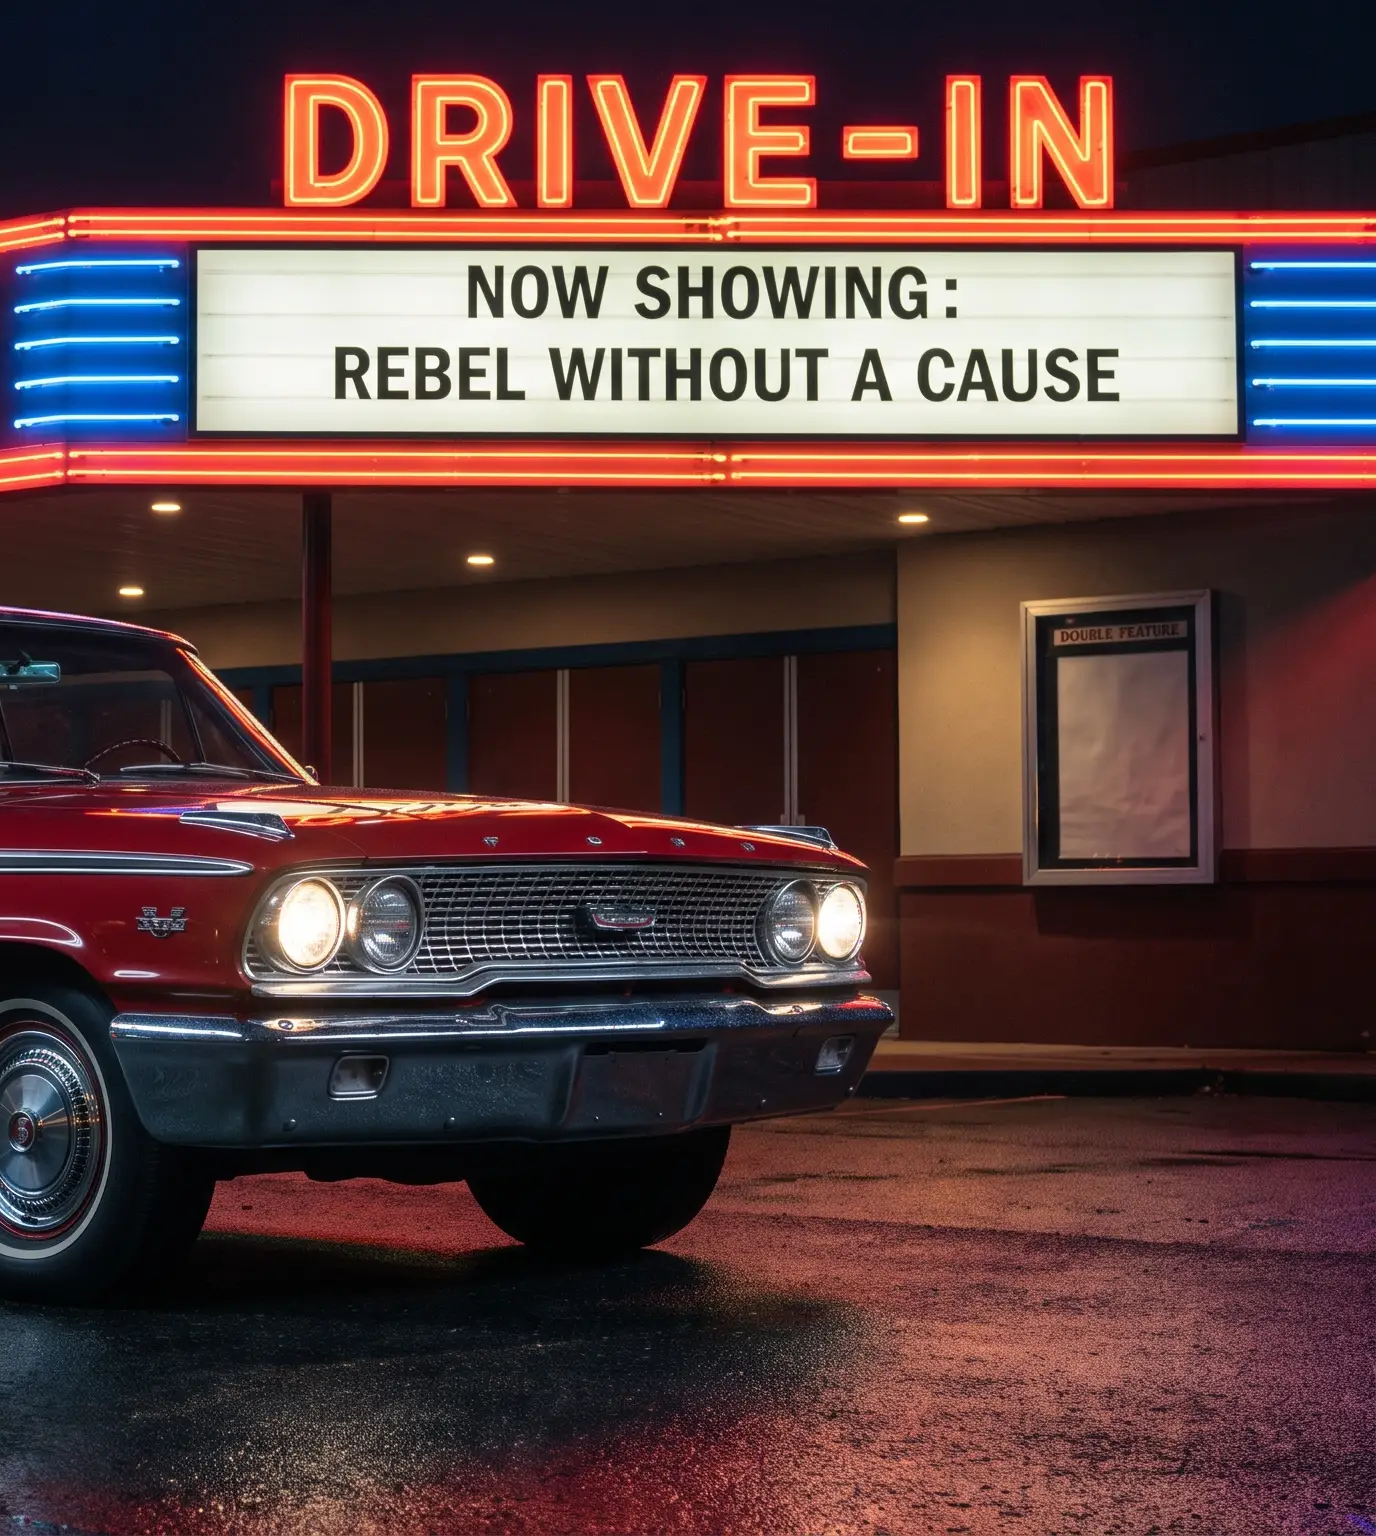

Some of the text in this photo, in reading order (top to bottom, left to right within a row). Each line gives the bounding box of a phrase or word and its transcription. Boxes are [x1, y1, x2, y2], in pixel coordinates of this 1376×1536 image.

[283, 73, 1114, 208] DRIVE-IN
[468, 265, 957, 320] NOW SHOWING:
[335, 346, 1120, 403] REBEL WITHOUT A CAUSE
[1118, 623, 1180, 639] FEATURE
